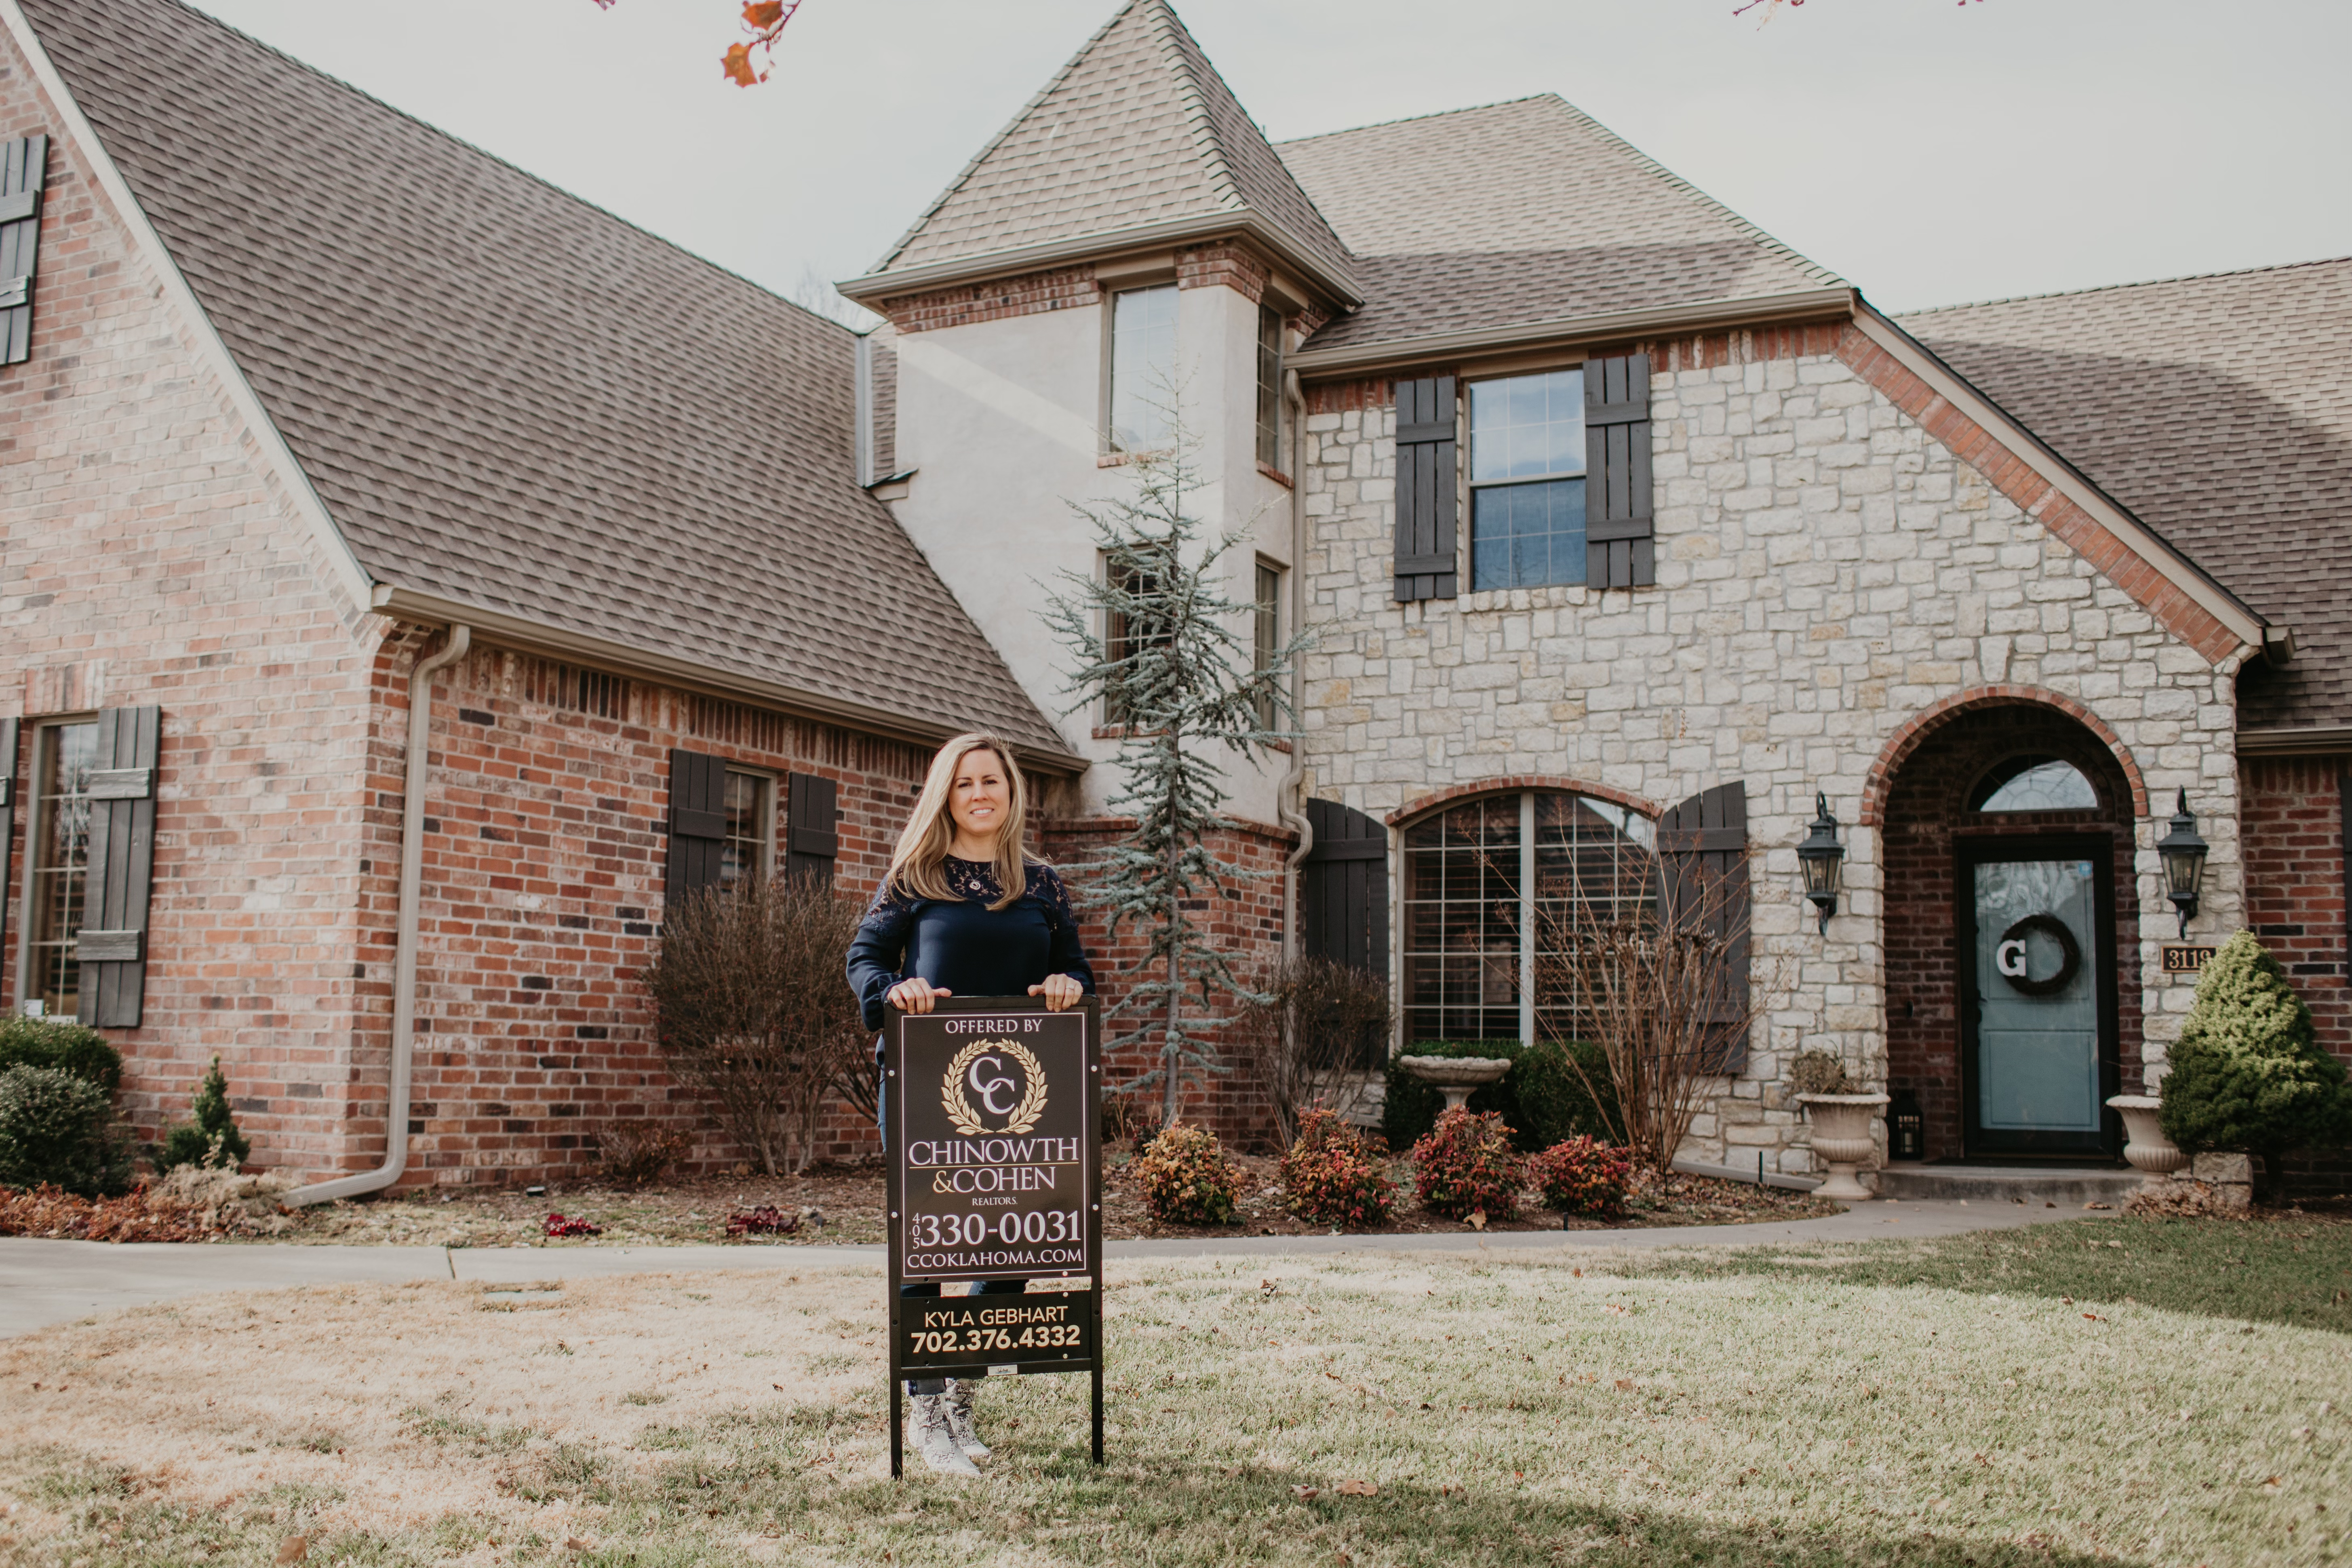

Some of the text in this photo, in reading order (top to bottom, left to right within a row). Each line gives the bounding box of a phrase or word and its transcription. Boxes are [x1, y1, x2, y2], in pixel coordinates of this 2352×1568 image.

[1996, 939, 2026, 976] G
[945, 1019, 1042, 1034] OFFERED BY
[909, 1138, 1078, 1166] CHINOWTH
[921, 1210, 1081, 1247] 330-0031
[907, 1249, 1082, 1268] CCOKLAHOMA.COM
[925, 1306, 1068, 1327] KYLA GEBHART
[911, 1325, 1080, 1353] 702.376.4332
